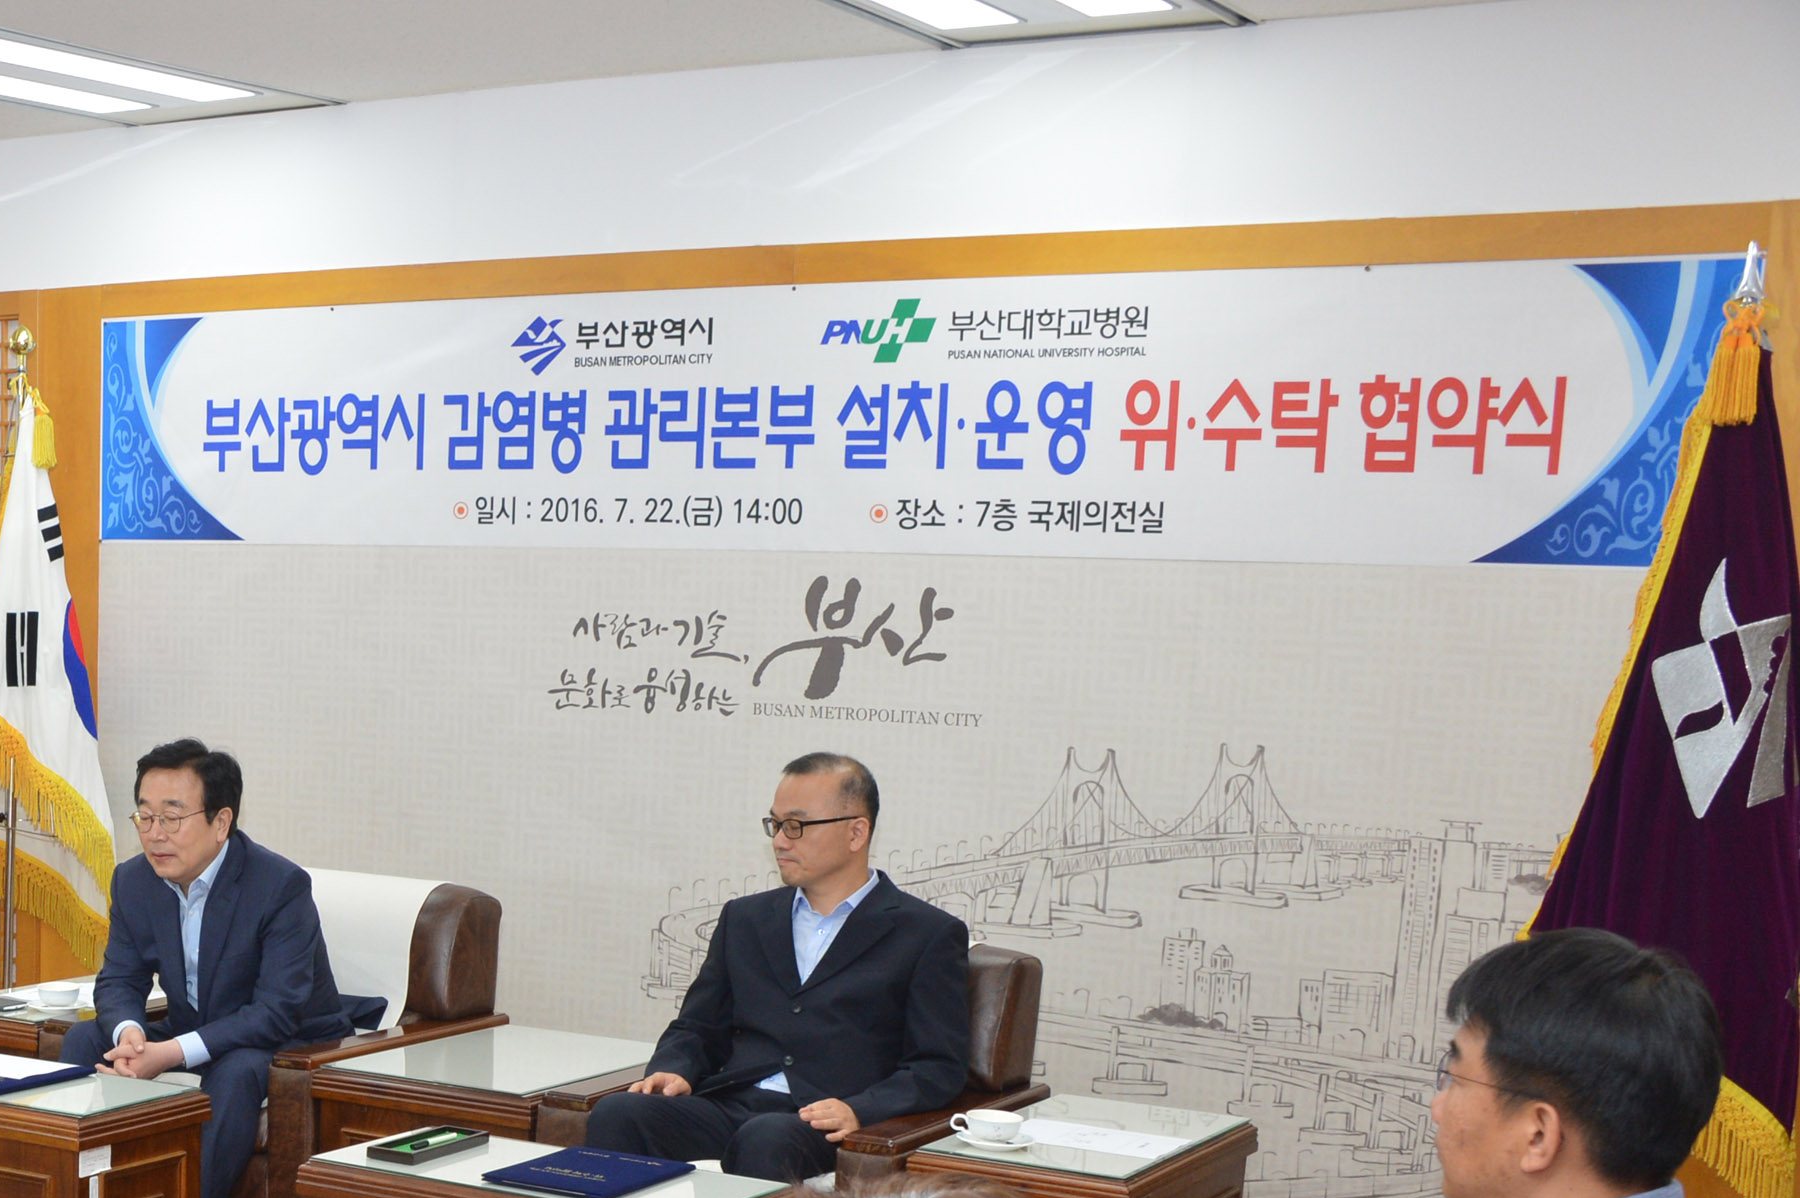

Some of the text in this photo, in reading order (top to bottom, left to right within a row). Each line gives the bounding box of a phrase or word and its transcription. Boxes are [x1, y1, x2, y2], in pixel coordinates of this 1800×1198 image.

[575, 316, 714, 350] 부산광역시
[947, 305, 1149, 342] 부산대학교병원
[574, 353, 713, 368] BUSAN METROPOLITAN CITY
[947, 346, 1147, 360] PUSAN NATIONAL UNIVERSITY HOSPITAL
[202, 374, 1569, 476] 부산광역시 감염병 관리본부 설치·운영 위·수탁 협약식
[475, 495, 517, 526] 일시
[540, 496, 605, 524] 2016.
[615, 497, 635, 524] 7.
[645, 495, 723, 528] 22.(금)
[733, 497, 803, 525] 14:00
[895, 497, 947, 531] 장소
[975, 498, 1018, 532] 7층
[1027, 499, 1166, 536] 국제의전실
[572, 612, 669, 650] 사람과
[752, 574, 956, 701] 부산
[547, 666, 741, 717] 문화로 융성하는
[752, 702, 983, 728] BUSAN METROPOLITAN CITY
